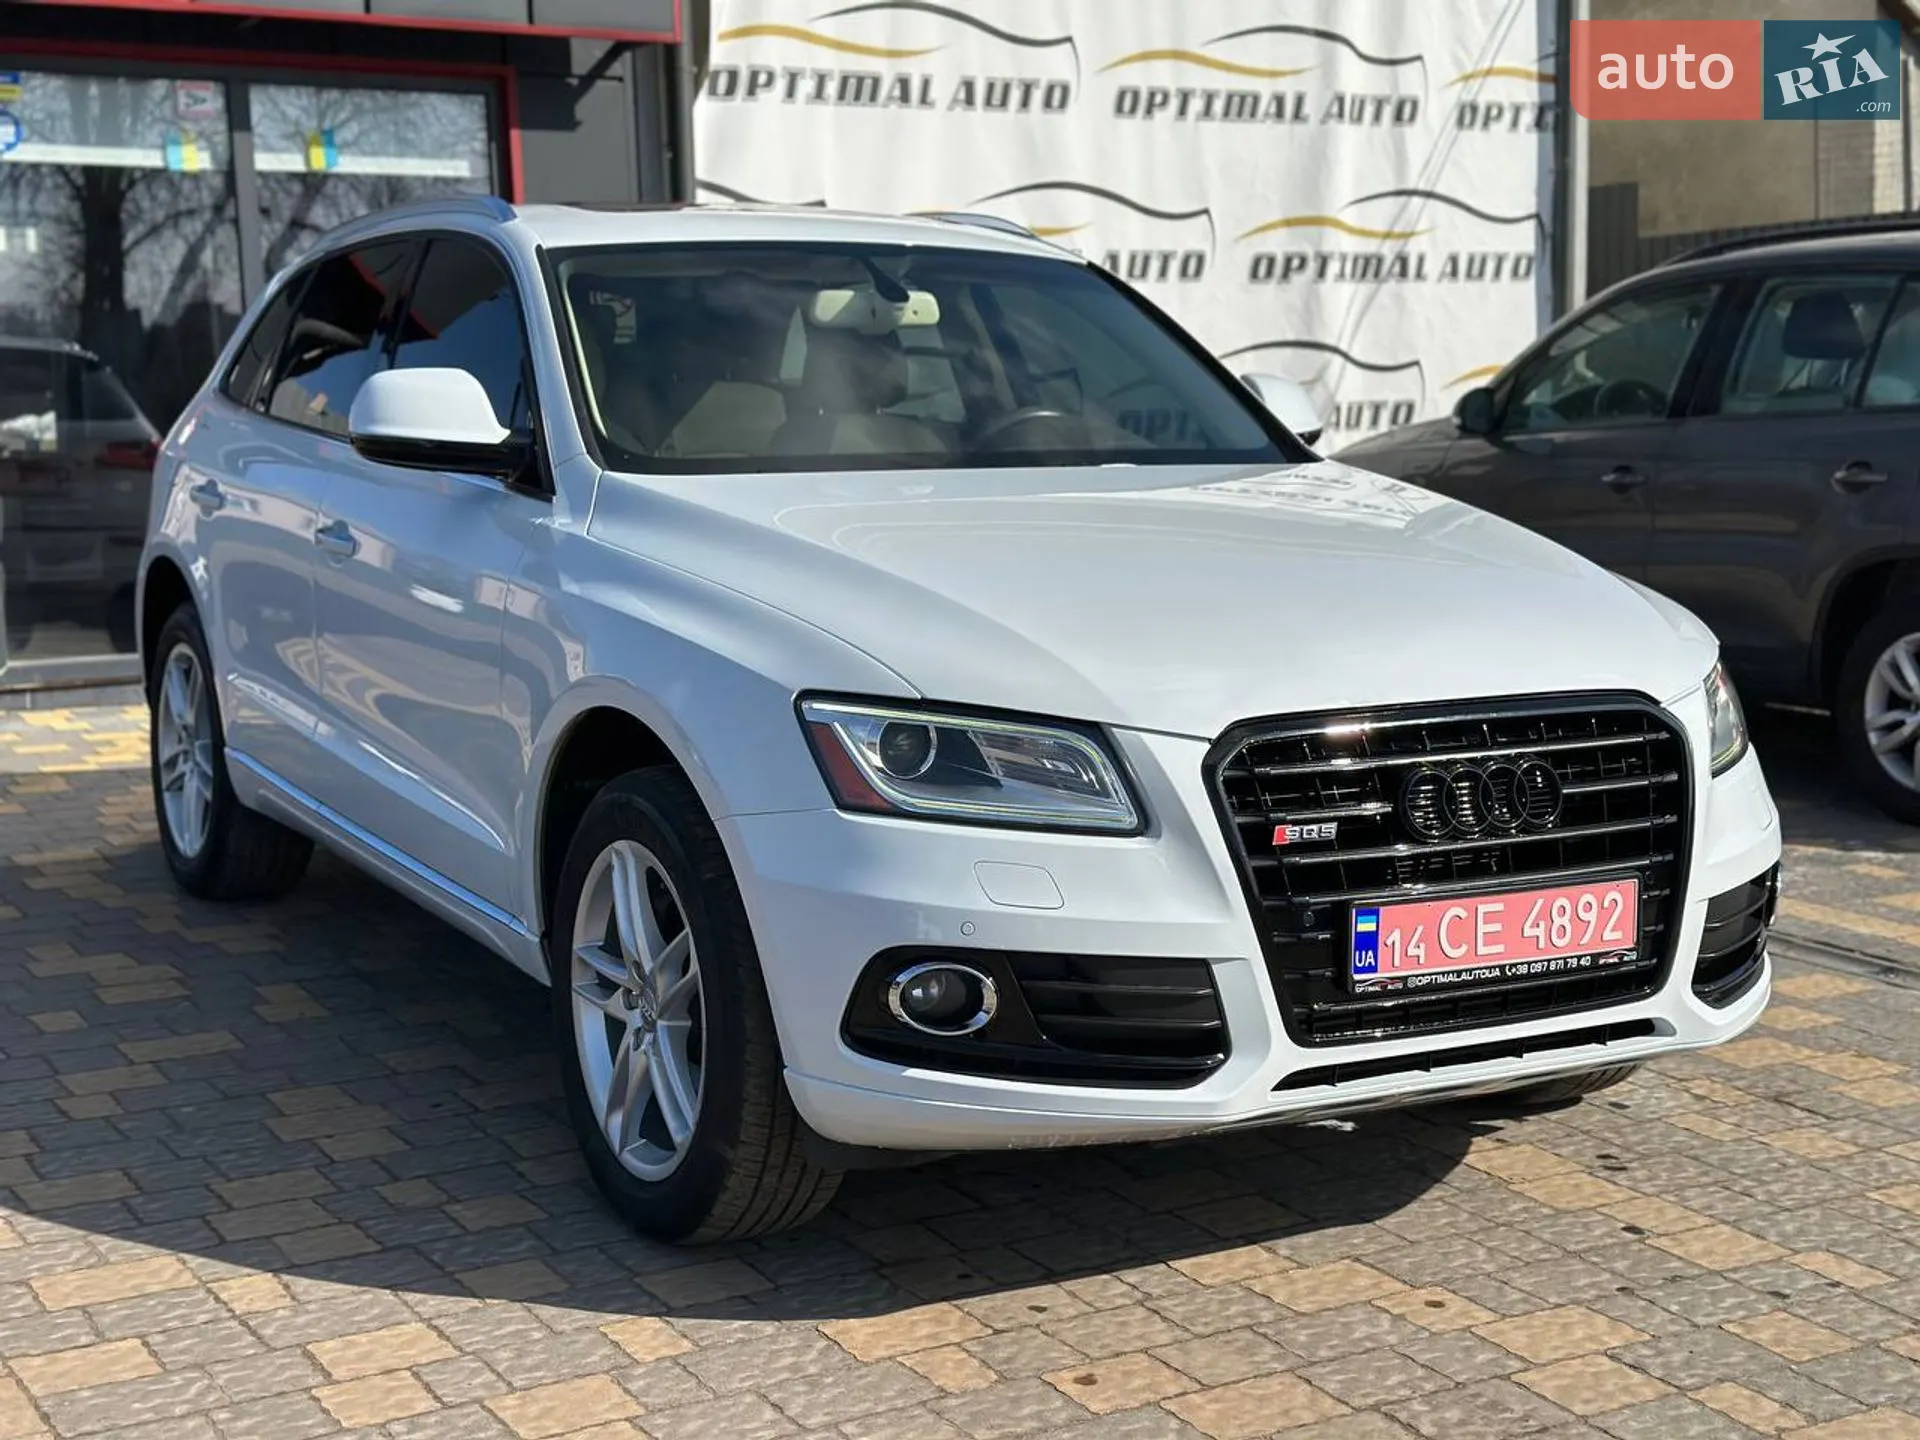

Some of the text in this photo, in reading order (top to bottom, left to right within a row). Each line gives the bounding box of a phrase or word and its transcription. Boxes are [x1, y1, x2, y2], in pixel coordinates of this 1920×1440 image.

[706, 64, 1072, 115] OPTIMAL AUTO
[1113, 86, 1419, 128] OPTIMAL AUTO
[1101, 249, 1206, 283] AUTO
[1250, 251, 1535, 285] OPTIMAL AUTO
[1323, 399, 1416, 433] AUTO
[1284, 822, 1337, 842] SQ5
[1384, 891, 1624, 968] 14 CE 4892
[1354, 950, 1376, 968] UA
